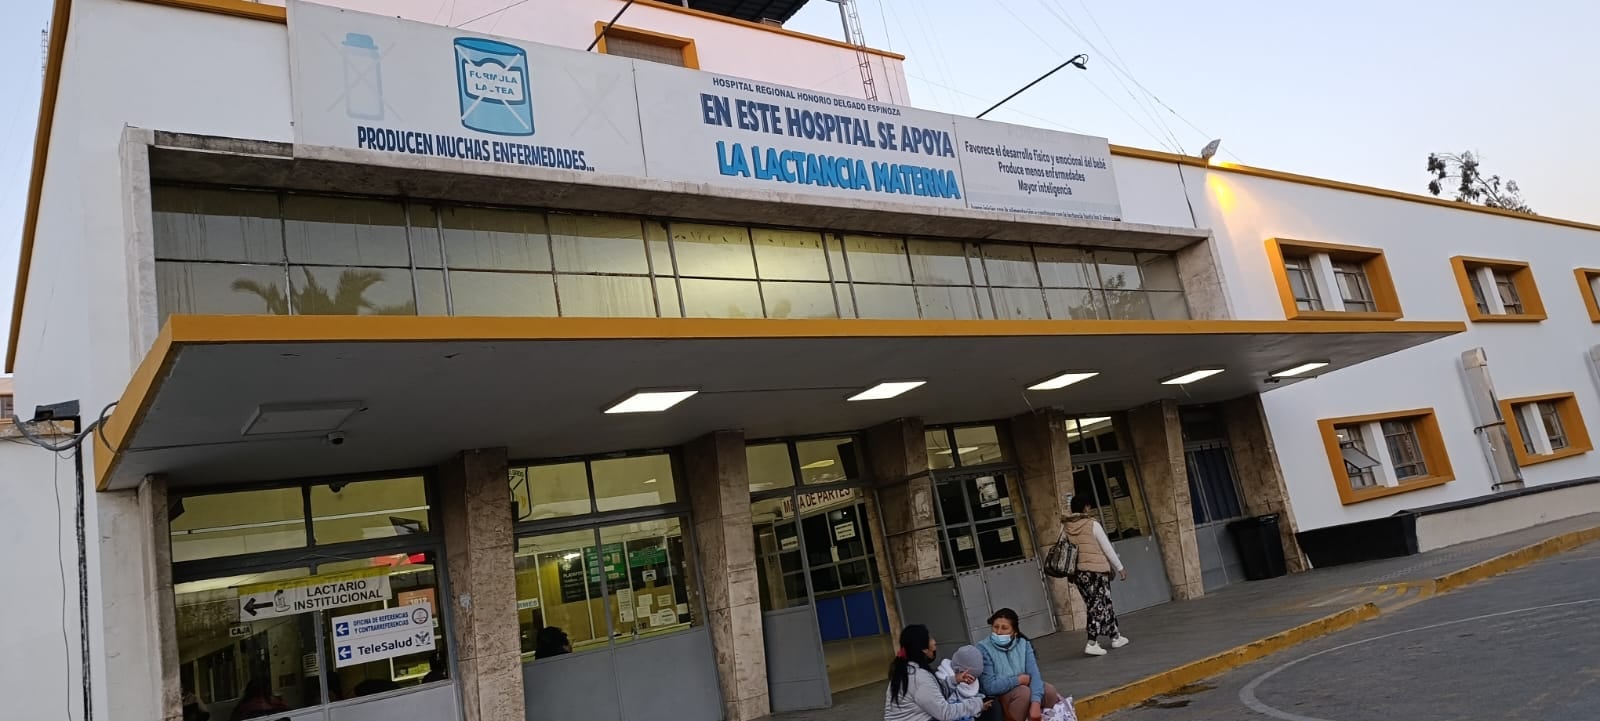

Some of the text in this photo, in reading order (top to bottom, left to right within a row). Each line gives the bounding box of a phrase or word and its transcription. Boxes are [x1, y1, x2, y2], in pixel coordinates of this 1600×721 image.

[475, 83, 515, 95] LATEA
[712, 78, 901, 116] HOSPITAL REGIONAL HONORIO DELGADO ESPINOZA
[700, 93, 956, 158] EN ESTE HOSPITAL SE APOYA
[357, 126, 595, 172] PRODUCEN MUCHAS ENFERMEDADES...
[964, 140, 995, 156] Favorece
[995, 144, 1002, 157] el
[1002, 144, 1033, 161] desarrollo
[1050, 153, 1055, 166] y
[1055, 153, 1084, 167] emocional
[1083, 155, 1093, 168] del
[716, 140, 962, 199] LA LACTANCIA MATERNA
[998, 161, 1086, 182] Produce menos enfermedades
[1017, 179, 1073, 198] Mayor inteligencia
[784, 496, 806, 513] MEA
[805, 493, 817, 507] DE
[306, 580, 366, 598] LACTARIO
[294, 589, 383, 611] INSTITUCIONAL
[353, 611, 409, 627] OFICINA DE REFERENCIAS
[358, 619, 410, 634] CONTRARREFERENCIAS
[231, 625, 251, 637] CAJA
[357, 636, 413, 656] TeleSalud
